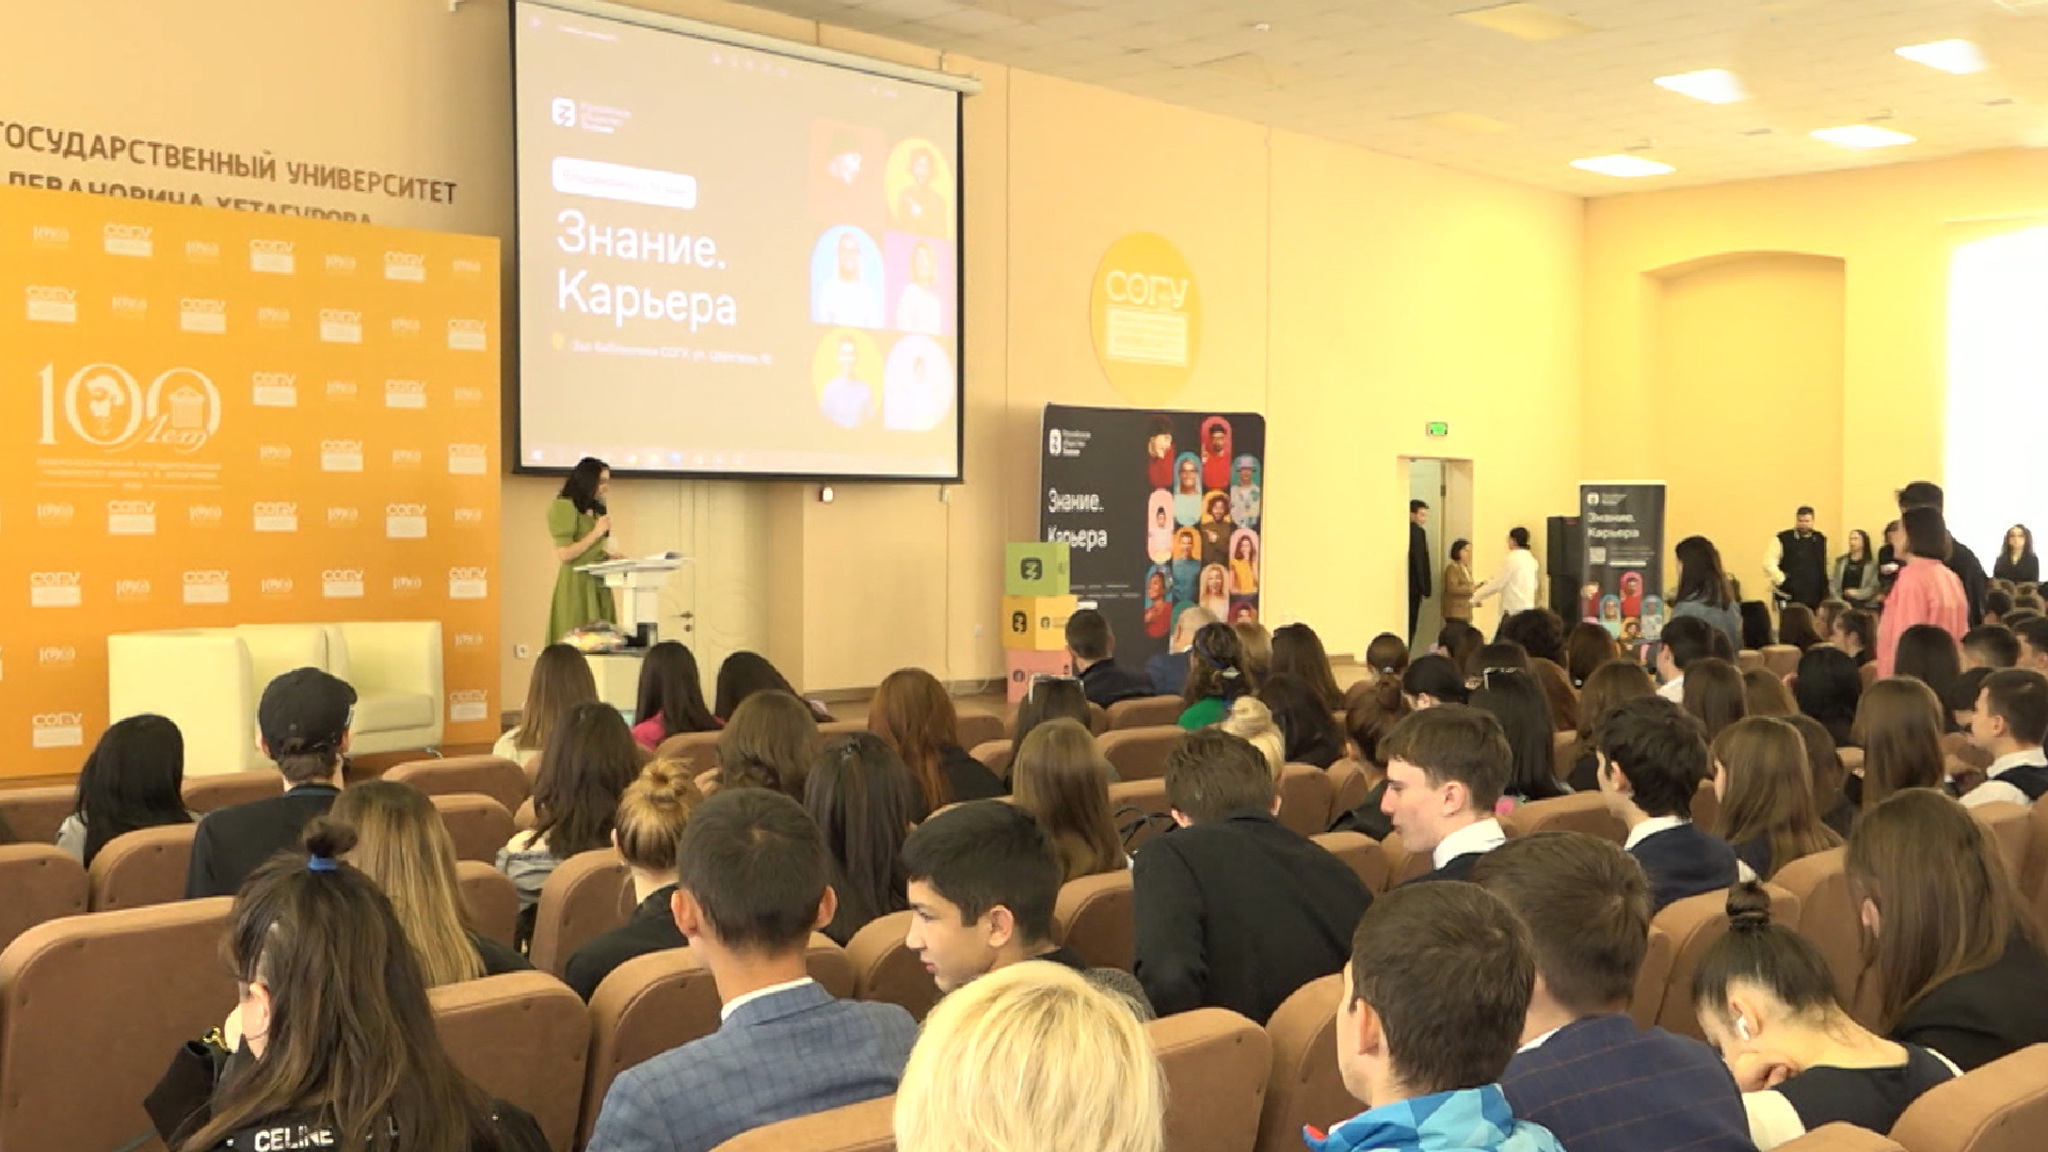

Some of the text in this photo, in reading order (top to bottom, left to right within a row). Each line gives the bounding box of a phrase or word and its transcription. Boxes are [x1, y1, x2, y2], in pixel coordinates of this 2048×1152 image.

[0, 121, 457, 204] ОСУДАРСТВЕННЫЙ УНИВЕРСИТЕТ
[557, 205, 726, 270] Знание.
[558, 267, 737, 333] Карьера
[1105, 269, 1190, 308] СОГУ
[37, 363, 221, 446] 100
[1048, 488, 1105, 513] Знание.
[1048, 525, 1108, 552] Карьера
[1587, 527, 1640, 540] Карьера
[254, 1126, 334, 1152] CELINE
